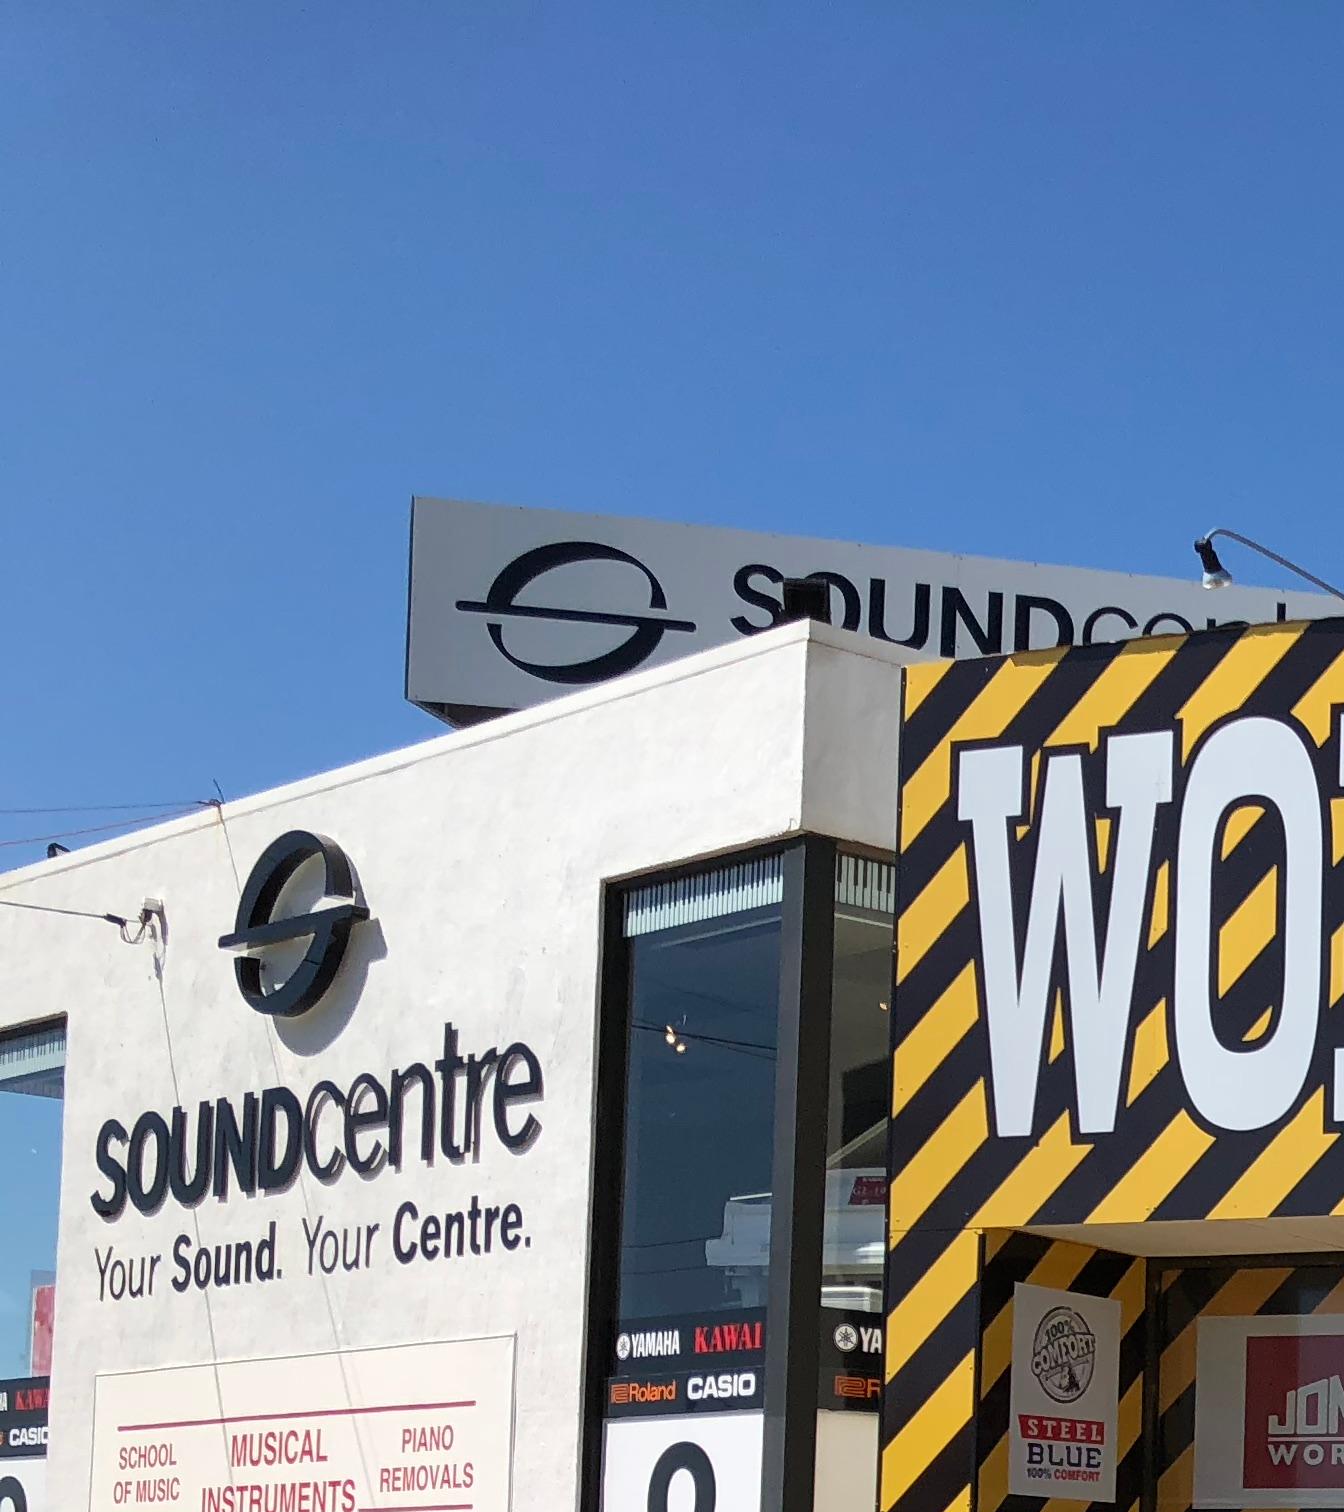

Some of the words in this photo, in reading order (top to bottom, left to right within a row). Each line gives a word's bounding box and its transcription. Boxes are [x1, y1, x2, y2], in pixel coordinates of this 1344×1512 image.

[90, 1021, 545, 1221] SOUNDcentre
[95, 1243, 163, 1302] Your
[170, 1222, 283, 1293] Sound.
[302, 1213, 380, 1275] Your
[391, 1197, 534, 1266] Centre.
[631, 1329, 680, 1358] YAMAHA
[694, 1322, 762, 1354] KAWAI
[1031, 1332, 1096, 1376] COMFORT
[629, 1380, 676, 1402] Roland
[687, 1373, 756, 1400] CASIO
[401, 1424, 454, 1453] PIANO
[1027, 1419, 1101, 1441] STEEL
[119, 1443, 177, 1471] SCHOOL
[230, 1428, 328, 1467] MUSICAL
[1027, 1442, 1102, 1468] BLUE
[379, 1462, 474, 1493] REMOVALS
[1027, 1467, 1051, 1480] 100%
[1053, 1470, 1100, 1482] COMFORT
[113, 1480, 132, 1505] OF
[135, 1476, 181, 1503] MUSIC
